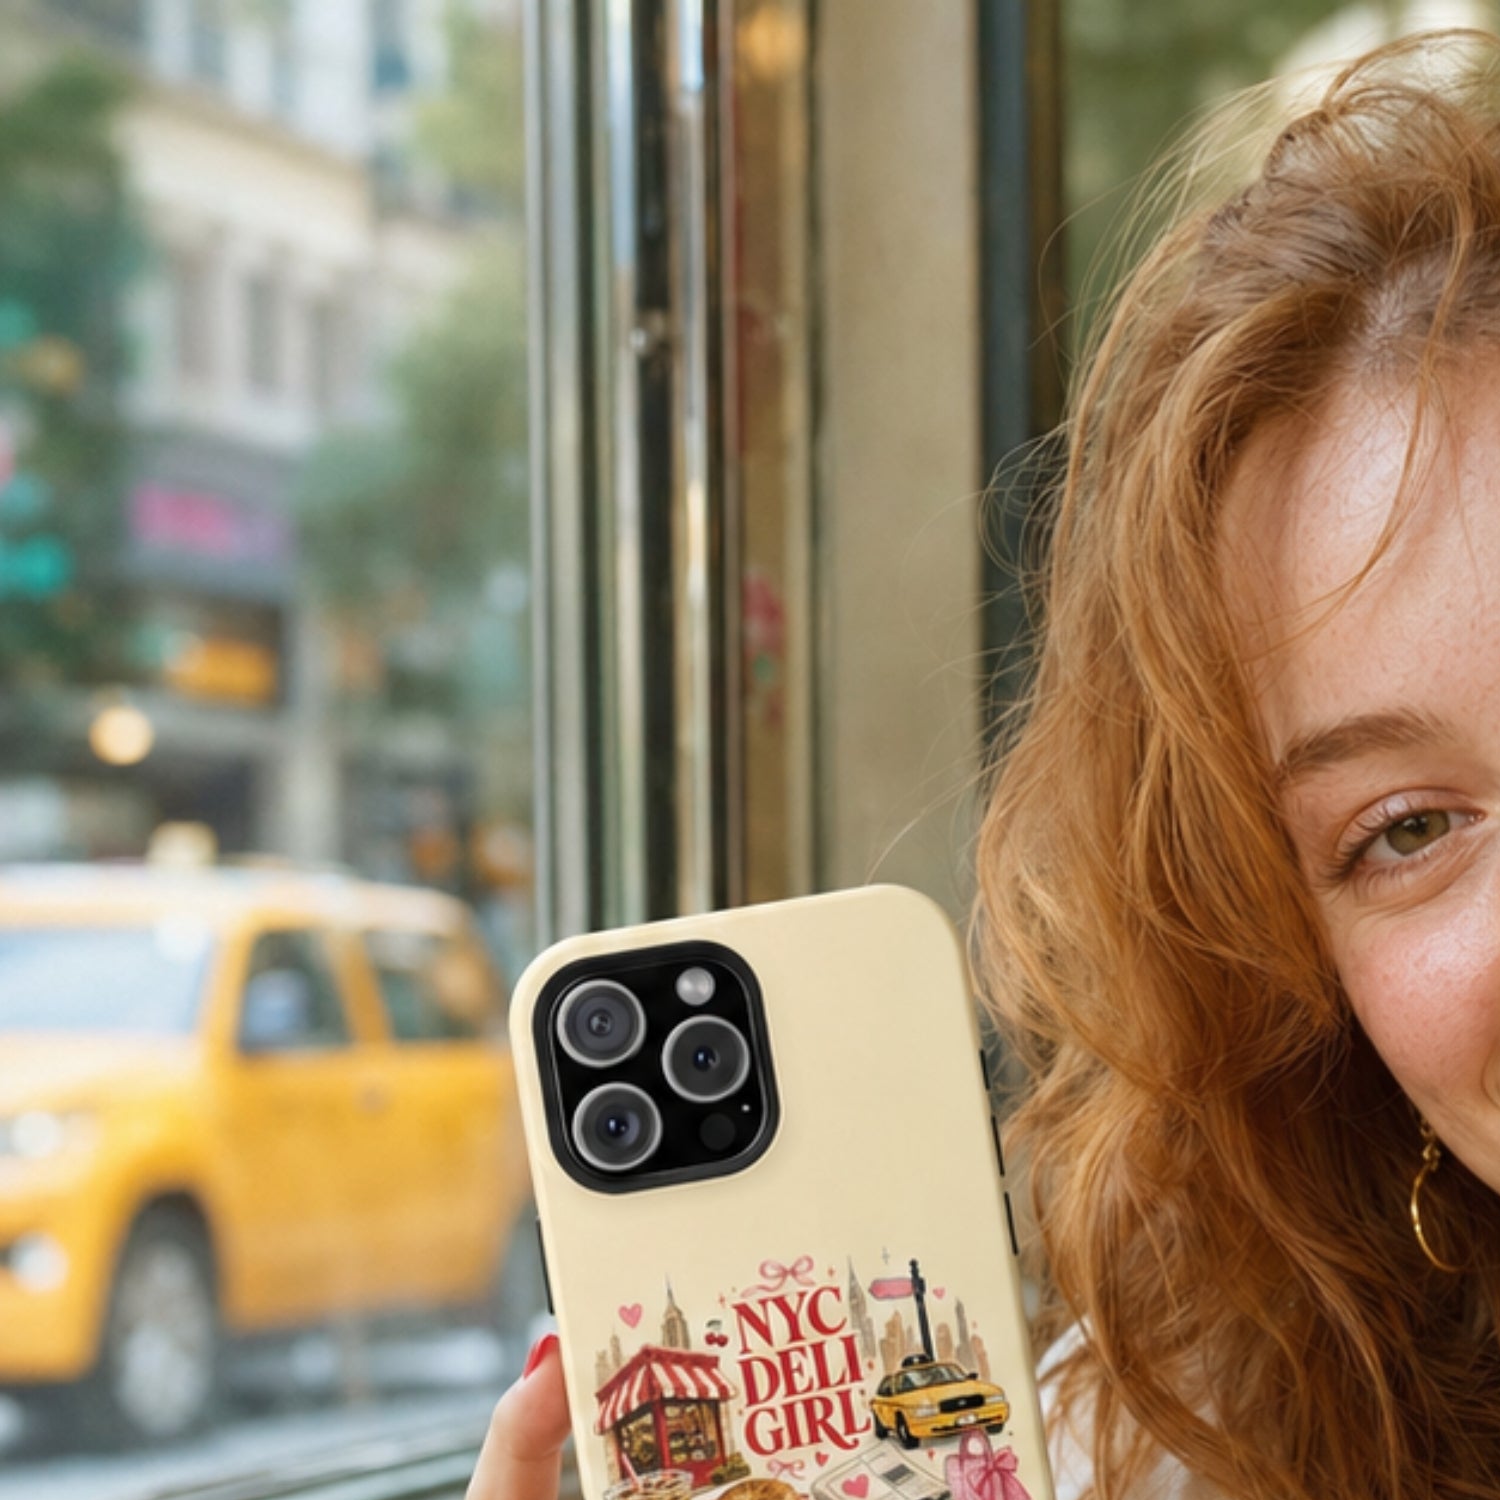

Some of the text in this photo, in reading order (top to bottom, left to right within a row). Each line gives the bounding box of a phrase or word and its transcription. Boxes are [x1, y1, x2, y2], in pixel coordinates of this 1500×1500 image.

[732, 1286, 848, 1354] NYC
[738, 1334, 864, 1408] DELI
[744, 1389, 872, 1456] GIRL
